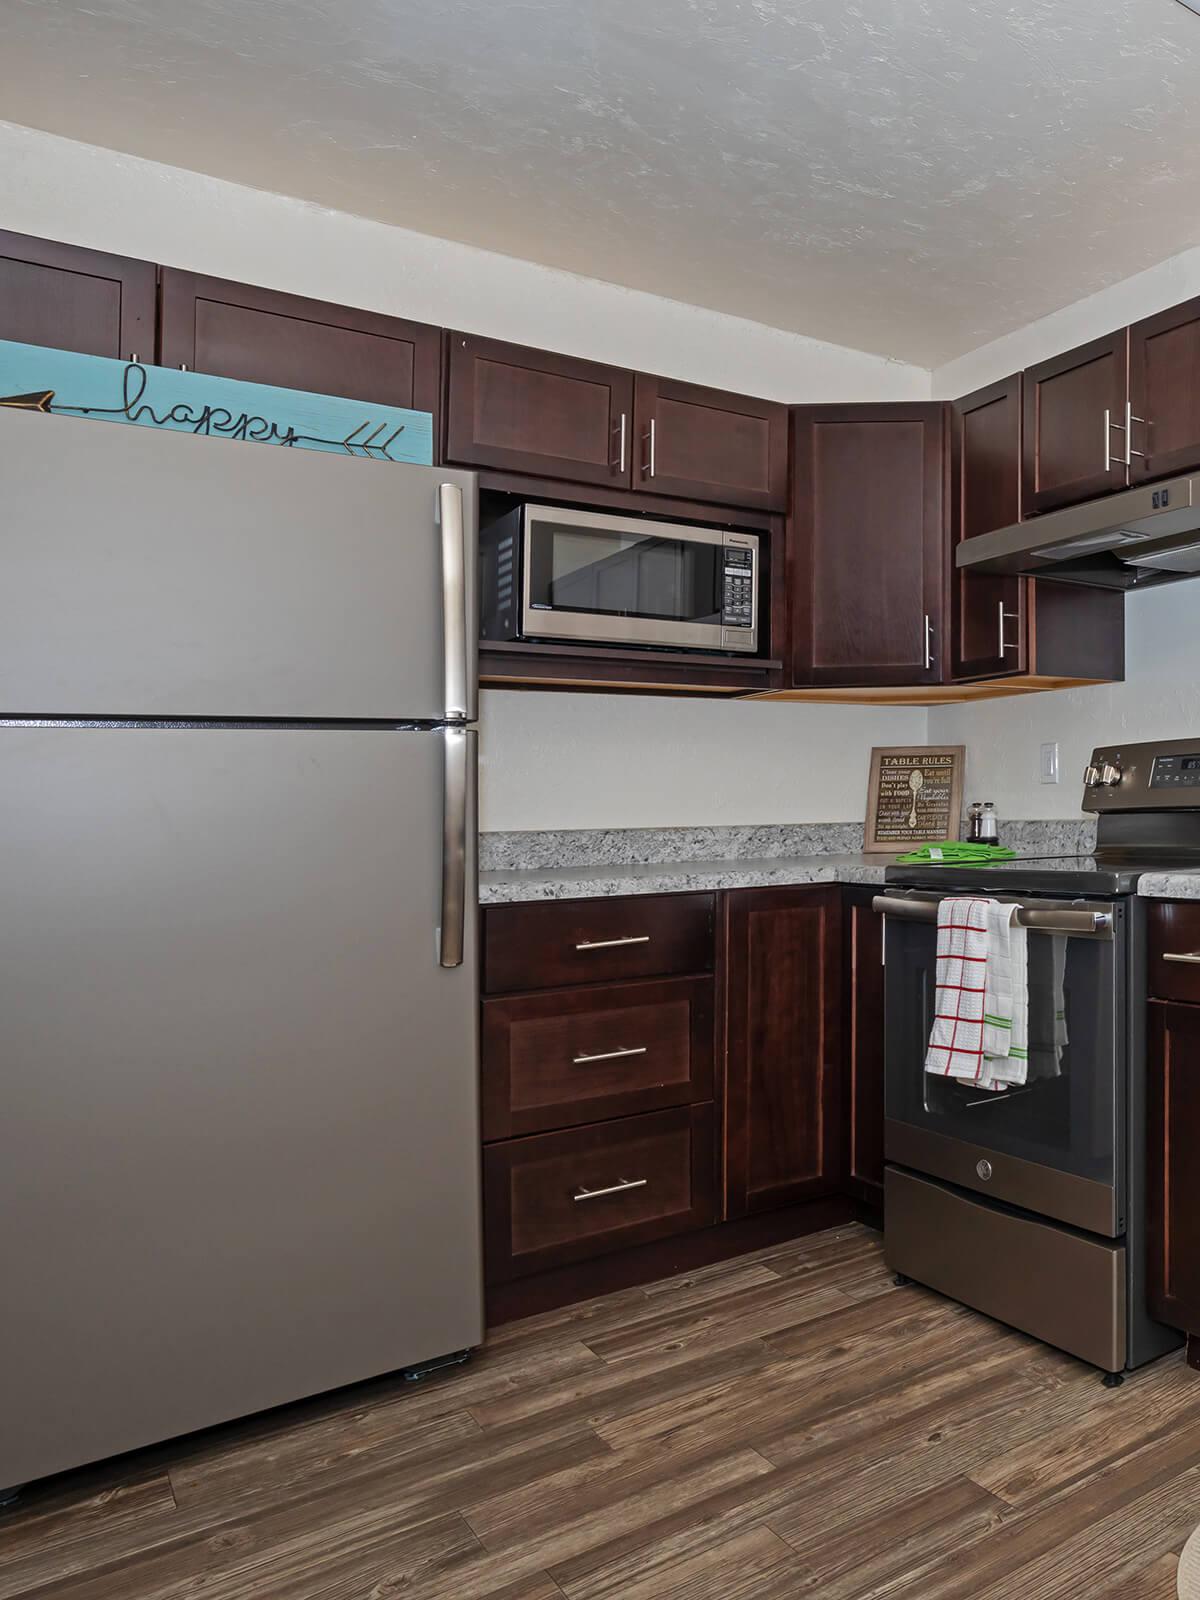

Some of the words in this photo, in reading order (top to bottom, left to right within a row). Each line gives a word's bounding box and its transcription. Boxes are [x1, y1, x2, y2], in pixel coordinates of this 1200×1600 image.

[124, 364, 298, 446] happy
[883, 757, 920, 766] TABLE
[922, 756, 952, 765] RULES
